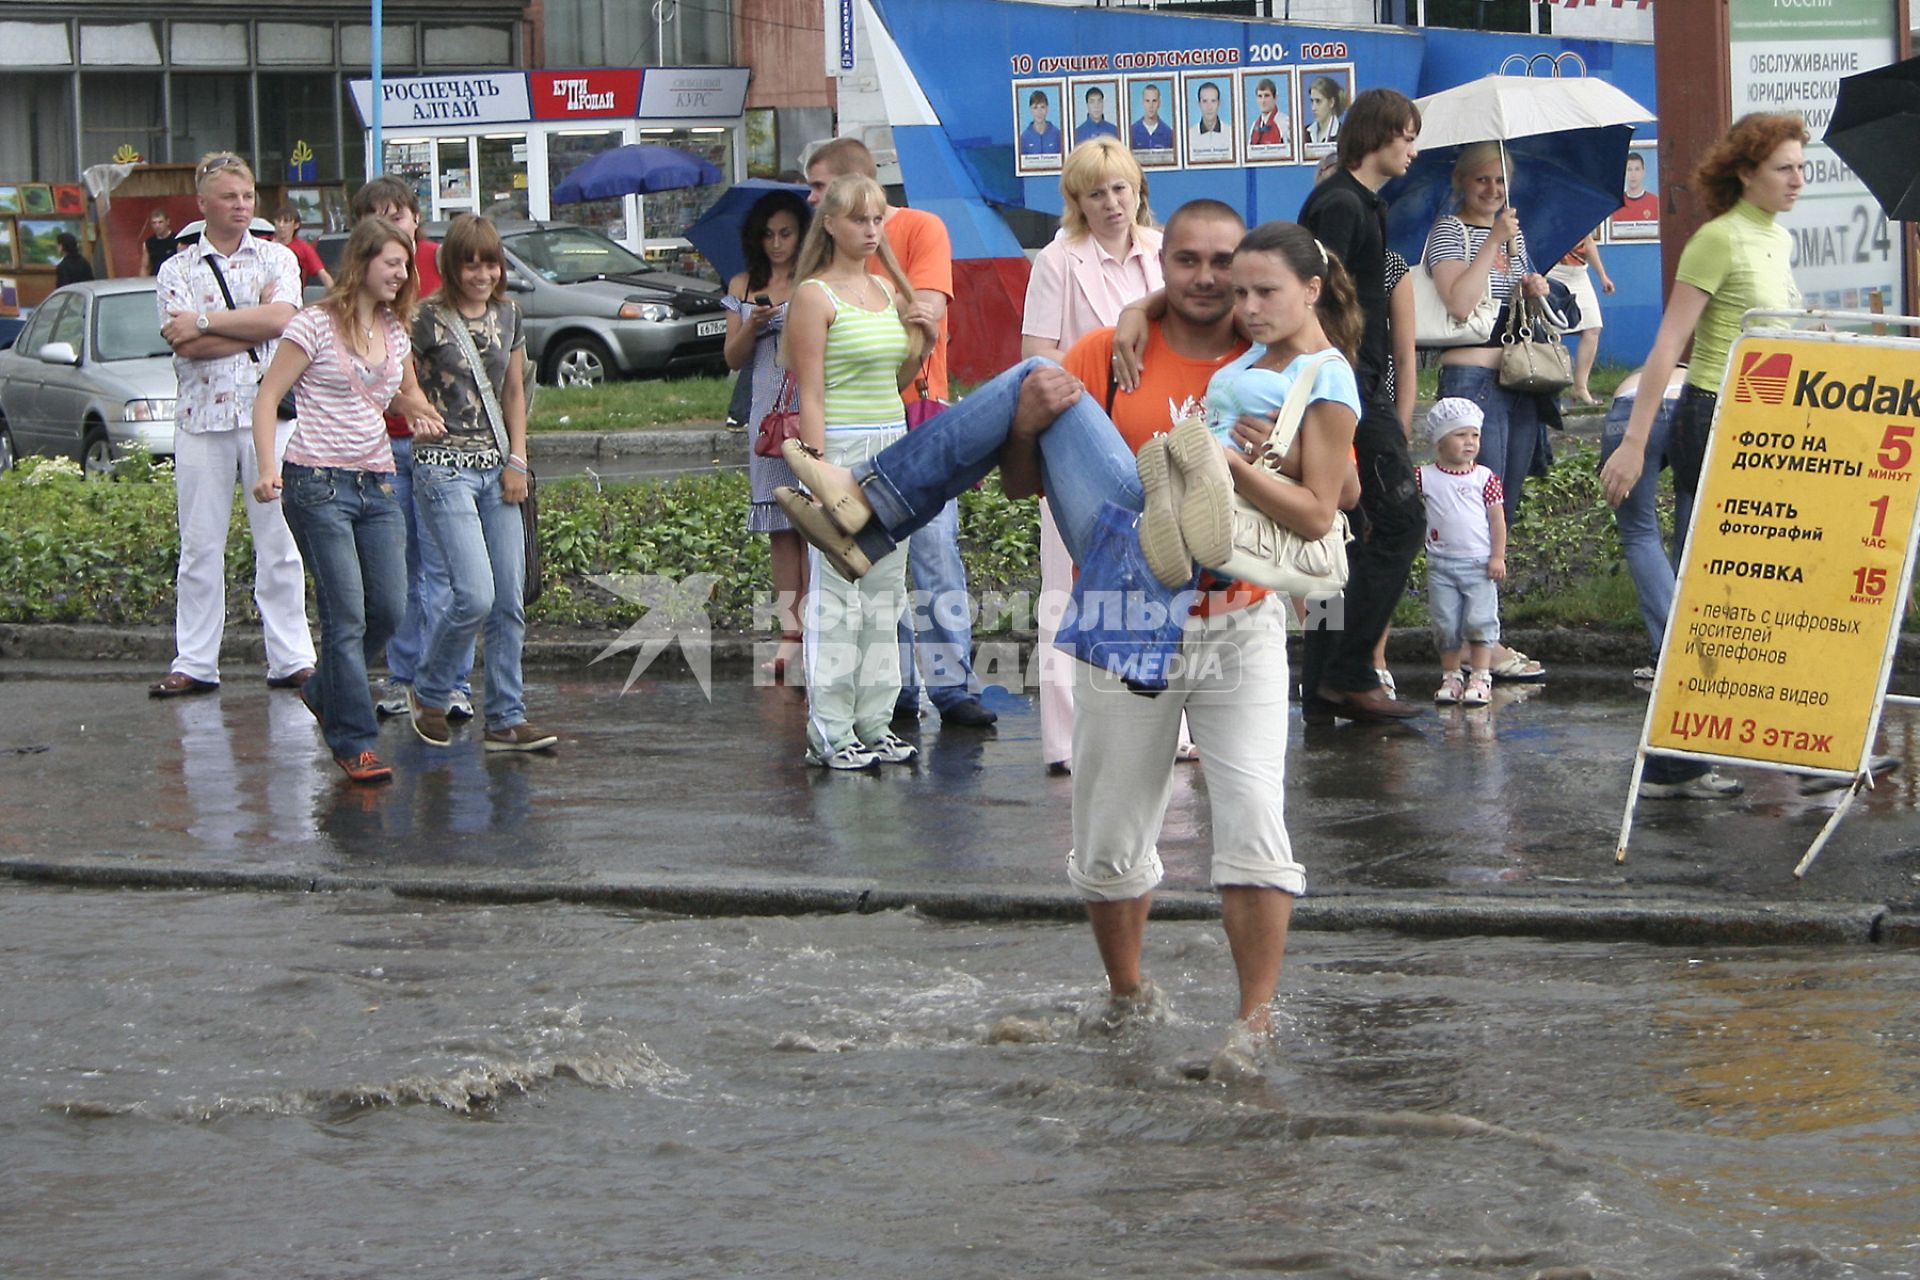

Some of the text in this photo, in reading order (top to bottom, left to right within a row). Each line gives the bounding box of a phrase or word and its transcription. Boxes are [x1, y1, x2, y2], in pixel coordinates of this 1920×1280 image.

[1011, 54, 1032, 75] 10
[1038, 54, 1109, 73] лучших
[1113, 48, 1240, 69] спортсменов
[1301, 42, 1347, 59] года
[1750, 52, 1858, 74] ОБСЛУЖИВАНИЕ
[383, 80, 500, 101] РОСПЕЧАТЬ
[1747, 81, 1839, 104] ЮРИДИЧЕСКИ
[413, 96, 480, 120] АЛТАЙ
[1851, 204, 1891, 263] 24
[1793, 370, 1920, 417] Kodak
[1739, 431, 1827, 452] ФОТО НА
[1877, 425, 1915, 470] 5
[1732, 452, 1863, 477] ДОКУМЕНТЫ
[1868, 468, 1912, 482] МИНУТ
[1724, 499, 1798, 519] ПЕЧАТЬ
[1869, 495, 1890, 537] 1
[1719, 520, 1823, 541] фотографий
[1861, 537, 1887, 549] ЧАС
[1710, 559, 1804, 583] ПРОЯВКА
[1853, 567, 1887, 596] 15
[1849, 594, 1883, 606] МИНУТ
[1703, 603, 1861, 634] печать с цифровых
[1689, 622, 1771, 643] носителей
[1685, 640, 1787, 664] и телефонов
[1688, 677, 1829, 707] оцифровка видео
[1670, 711, 1834, 753] ЦУМ 3 этаж
